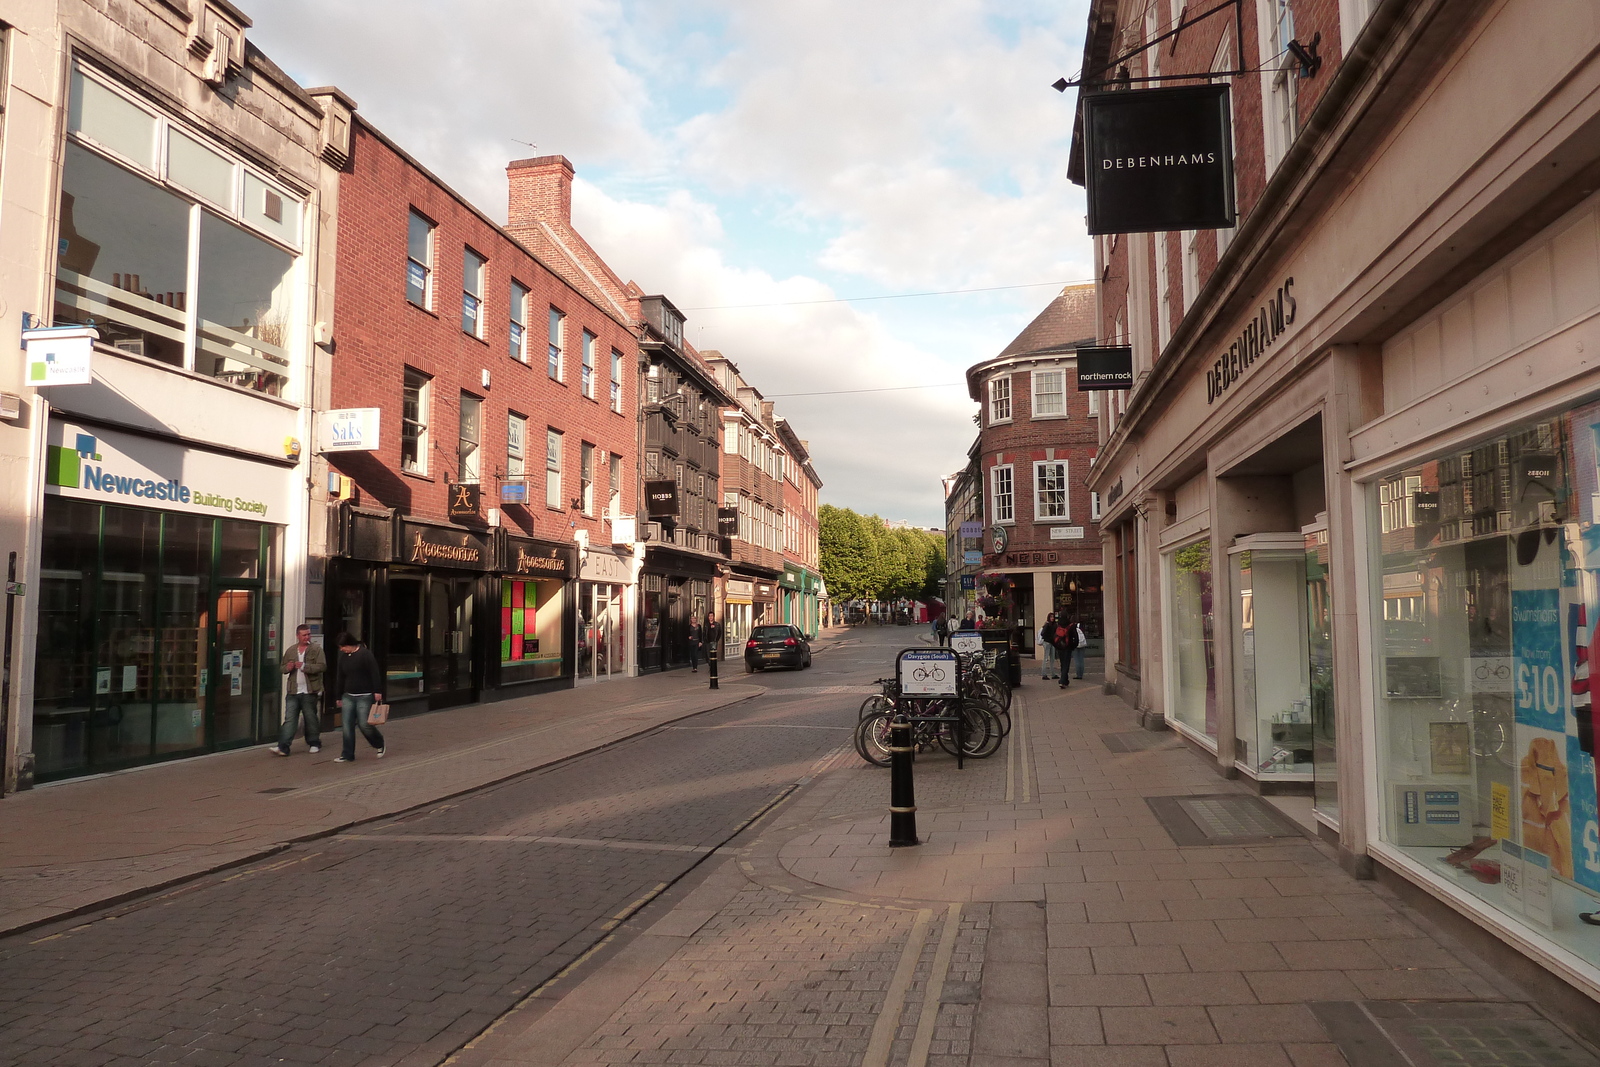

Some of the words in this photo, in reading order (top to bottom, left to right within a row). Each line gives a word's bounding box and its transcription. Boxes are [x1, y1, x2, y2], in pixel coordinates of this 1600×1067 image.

[1102, 152, 1215, 170] DEBENHAMS
[1206, 276, 1297, 405] DEBENHAMS
[49, 366, 86, 374] Newcastle
[1080, 372, 1114, 381] northern
[1114, 371, 1132, 379] rock
[332, 421, 362, 441] Saks
[84, 464, 191, 504] Newcastle
[193, 490, 233, 512] Building
[234, 496, 268, 517] Society
[595, 556, 620, 577] EAST
[1006, 552, 1058, 565] NERO
[1513, 605, 1558, 622] Swimshorts
[1522, 646, 1535, 659] Now
[1535, 647, 1551, 660] from
[1517, 662, 1559, 715] £10
[1503, 868, 1516, 882] HALF
[1503, 879, 1519, 894] PRICE
